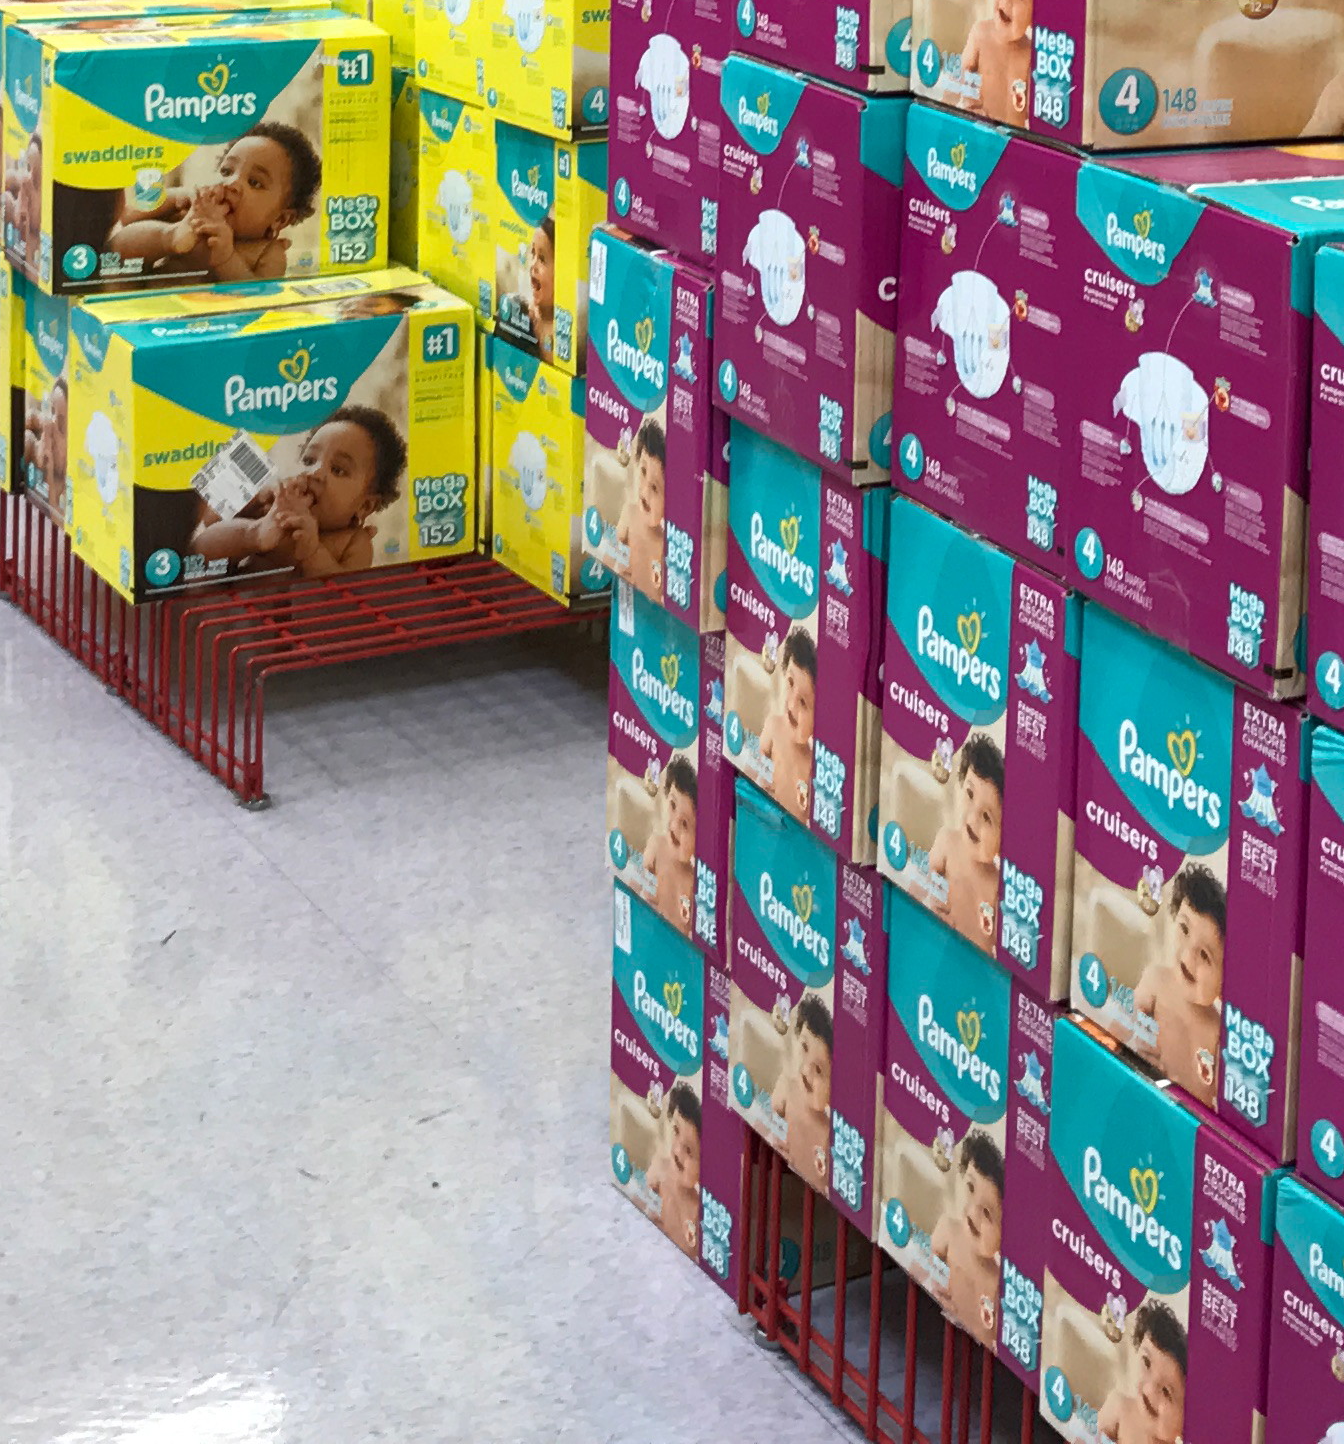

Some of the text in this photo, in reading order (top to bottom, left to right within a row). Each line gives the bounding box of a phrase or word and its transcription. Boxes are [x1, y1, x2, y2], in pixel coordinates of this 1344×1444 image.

[1035, 25, 1074, 57] Mega
[341, 53, 369, 80] #1
[1036, 52, 1071, 82] BOX
[144, 84, 256, 123] Pampers
[1035, 90, 1062, 124] 148
[1162, 87, 1197, 114] 148
[63, 145, 164, 165] swaddlers
[328, 197, 377, 212] Mega
[511, 169, 547, 209] Pampers
[330, 212, 375, 230] BOX
[331, 241, 366, 262] 152
[1105, 212, 1166, 265] Pampers
[72, 246, 88, 268] 3
[427, 332, 454, 356] #1
[606, 323, 665, 390] Pampers
[225, 374, 338, 415] Pampers
[143, 440, 224, 467] swaddl
[414, 473, 466, 496] Mega
[418, 491, 465, 513] BOX
[419, 521, 456, 546] 152
[751, 512, 814, 597] Pampers
[730, 581, 776, 630] cruisers
[917, 604, 1002, 701] Pampers
[1117, 717, 1221, 830] Pampers
[759, 871, 831, 969] Pampers
[1082, 1144, 1184, 1276] Pampers
